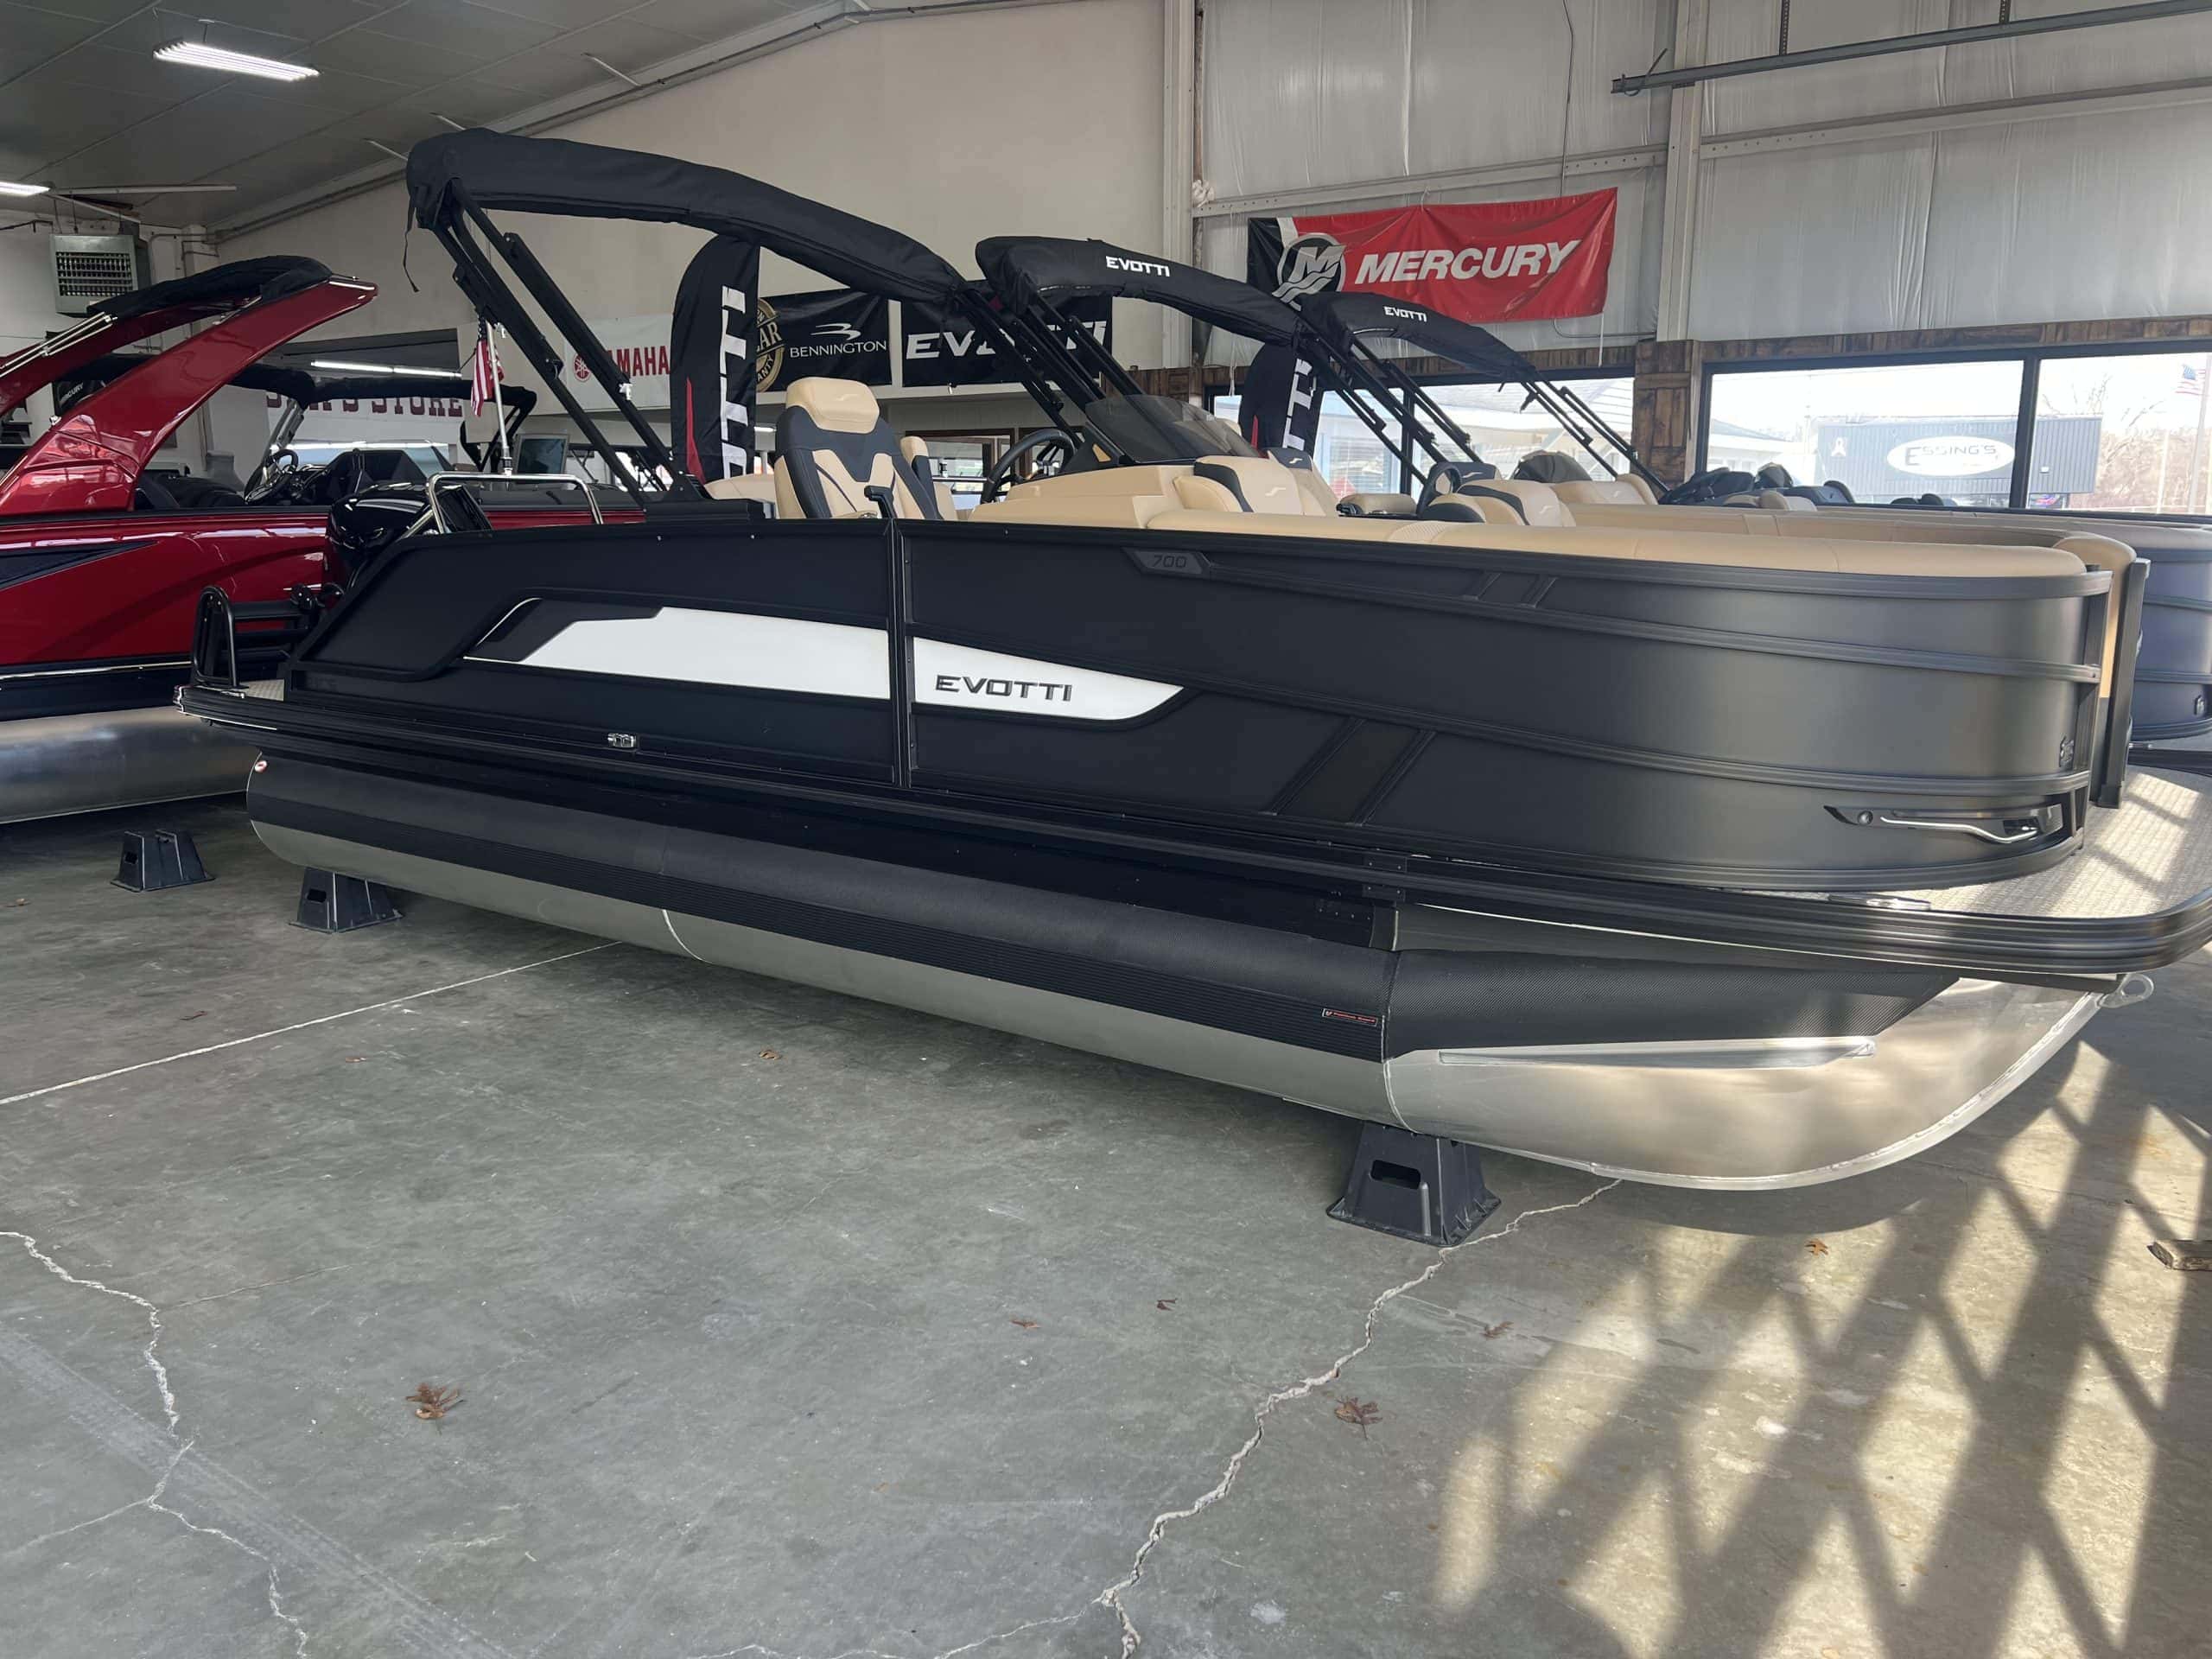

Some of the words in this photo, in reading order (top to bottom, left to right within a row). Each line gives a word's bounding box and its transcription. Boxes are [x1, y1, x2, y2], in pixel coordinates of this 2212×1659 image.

[1105, 256, 1170, 277] EVOTTI
[1355, 238, 1581, 285] MERCURY
[1383, 306, 1427, 322] EVOTTI
[790, 340, 887, 359] BENNINGTON
[607, 346, 671, 378] MAHA
[1152, 555, 1187, 568] 700
[936, 674, 1073, 702] EVOTTI
